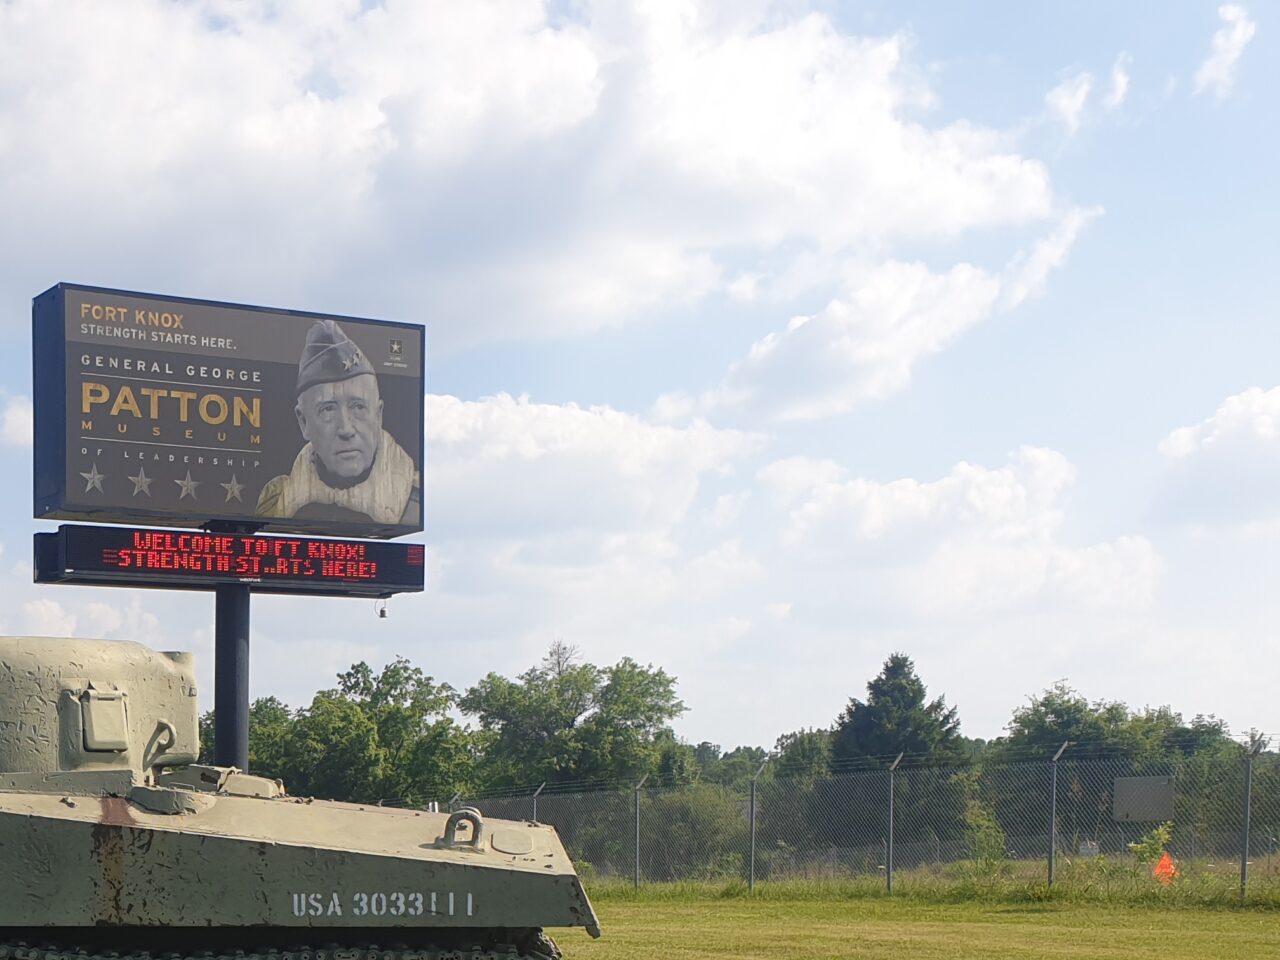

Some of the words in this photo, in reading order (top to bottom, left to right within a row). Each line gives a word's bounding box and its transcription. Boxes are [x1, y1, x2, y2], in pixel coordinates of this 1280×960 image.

[81, 303, 127, 322] FORT
[135, 310, 184, 329] KNOX
[81, 323, 146, 341] STRENGTH
[151, 332, 197, 346] STARTS
[201, 336, 237, 350] HERE.
[81, 355, 174, 374] GENERAL
[186, 365, 261, 382] GEORGE
[82, 382, 261, 428] PATTON
[81, 421, 261, 444] MUSEUM
[81, 447, 103, 456] OF
[124, 451, 260, 468] LEADERSHIP
[134, 532, 233, 554] WELCOME
[241, 538, 268, 556] TO
[274, 540, 301, 557] FT
[307, 543, 365, 560] KNOX!
[118, 550, 229, 572] STRENGTH
[322, 560, 377, 578] HERE!
[293, 892, 342, 917] USA
[352, 891, 473, 917] 3033111
